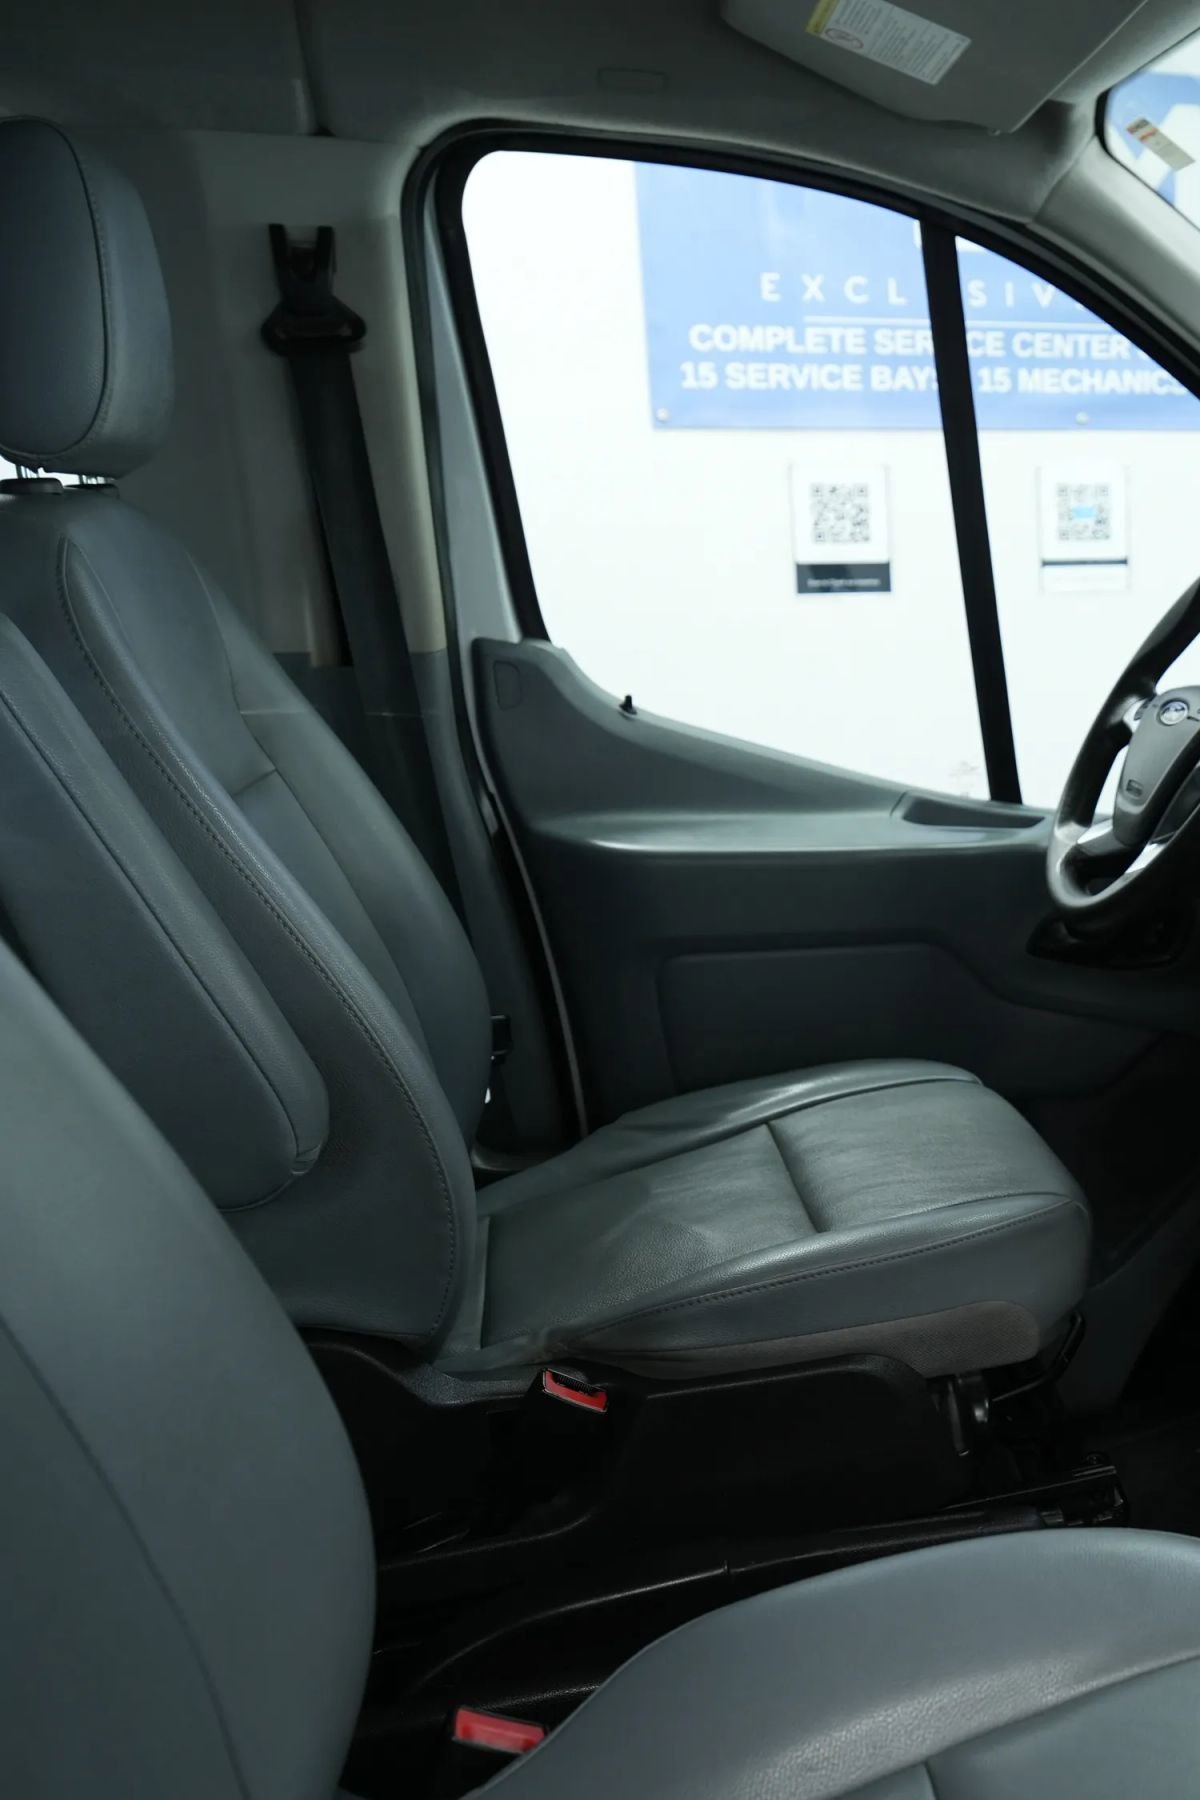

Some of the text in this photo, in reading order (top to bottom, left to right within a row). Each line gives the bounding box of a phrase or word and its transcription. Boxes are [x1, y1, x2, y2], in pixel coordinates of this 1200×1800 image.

[760, 271, 1088, 310] EXCLSIV
[689, 323, 1131, 361] COMPLETE SERCE CENTER
[680, 361, 718, 390] 15
[725, 361, 856, 391] SERVICE
[977, 366, 1011, 394] 15
